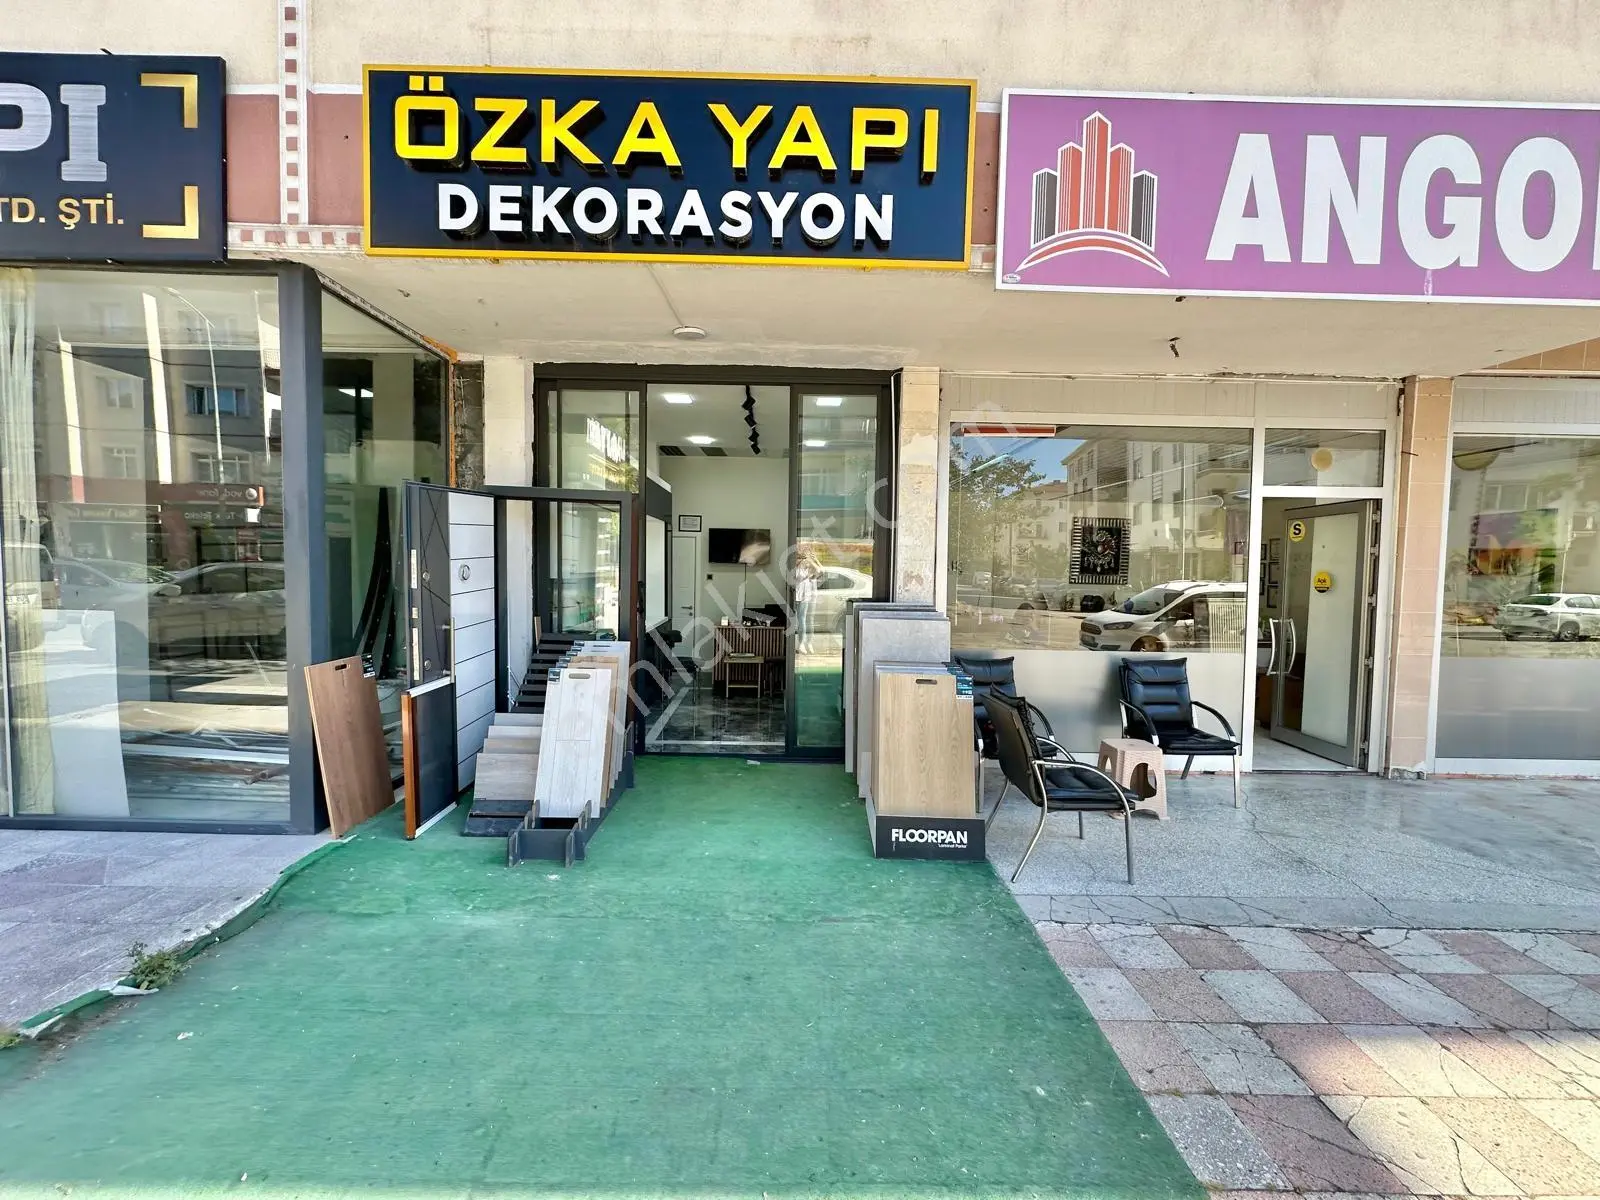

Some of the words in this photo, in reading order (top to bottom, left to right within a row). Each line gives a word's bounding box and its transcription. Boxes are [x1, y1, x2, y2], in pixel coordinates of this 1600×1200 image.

[394, 75, 682, 167] ÖZKA
[708, 103, 939, 173] YAPI
[58, 192, 124, 230] ŞTİ.
[437, 183, 894, 242] DEKORASYON
[1206, 133, 1600, 273] ANGO
[1293, 523, 1302, 536] S
[891, 828, 968, 844] FLOORPAN
